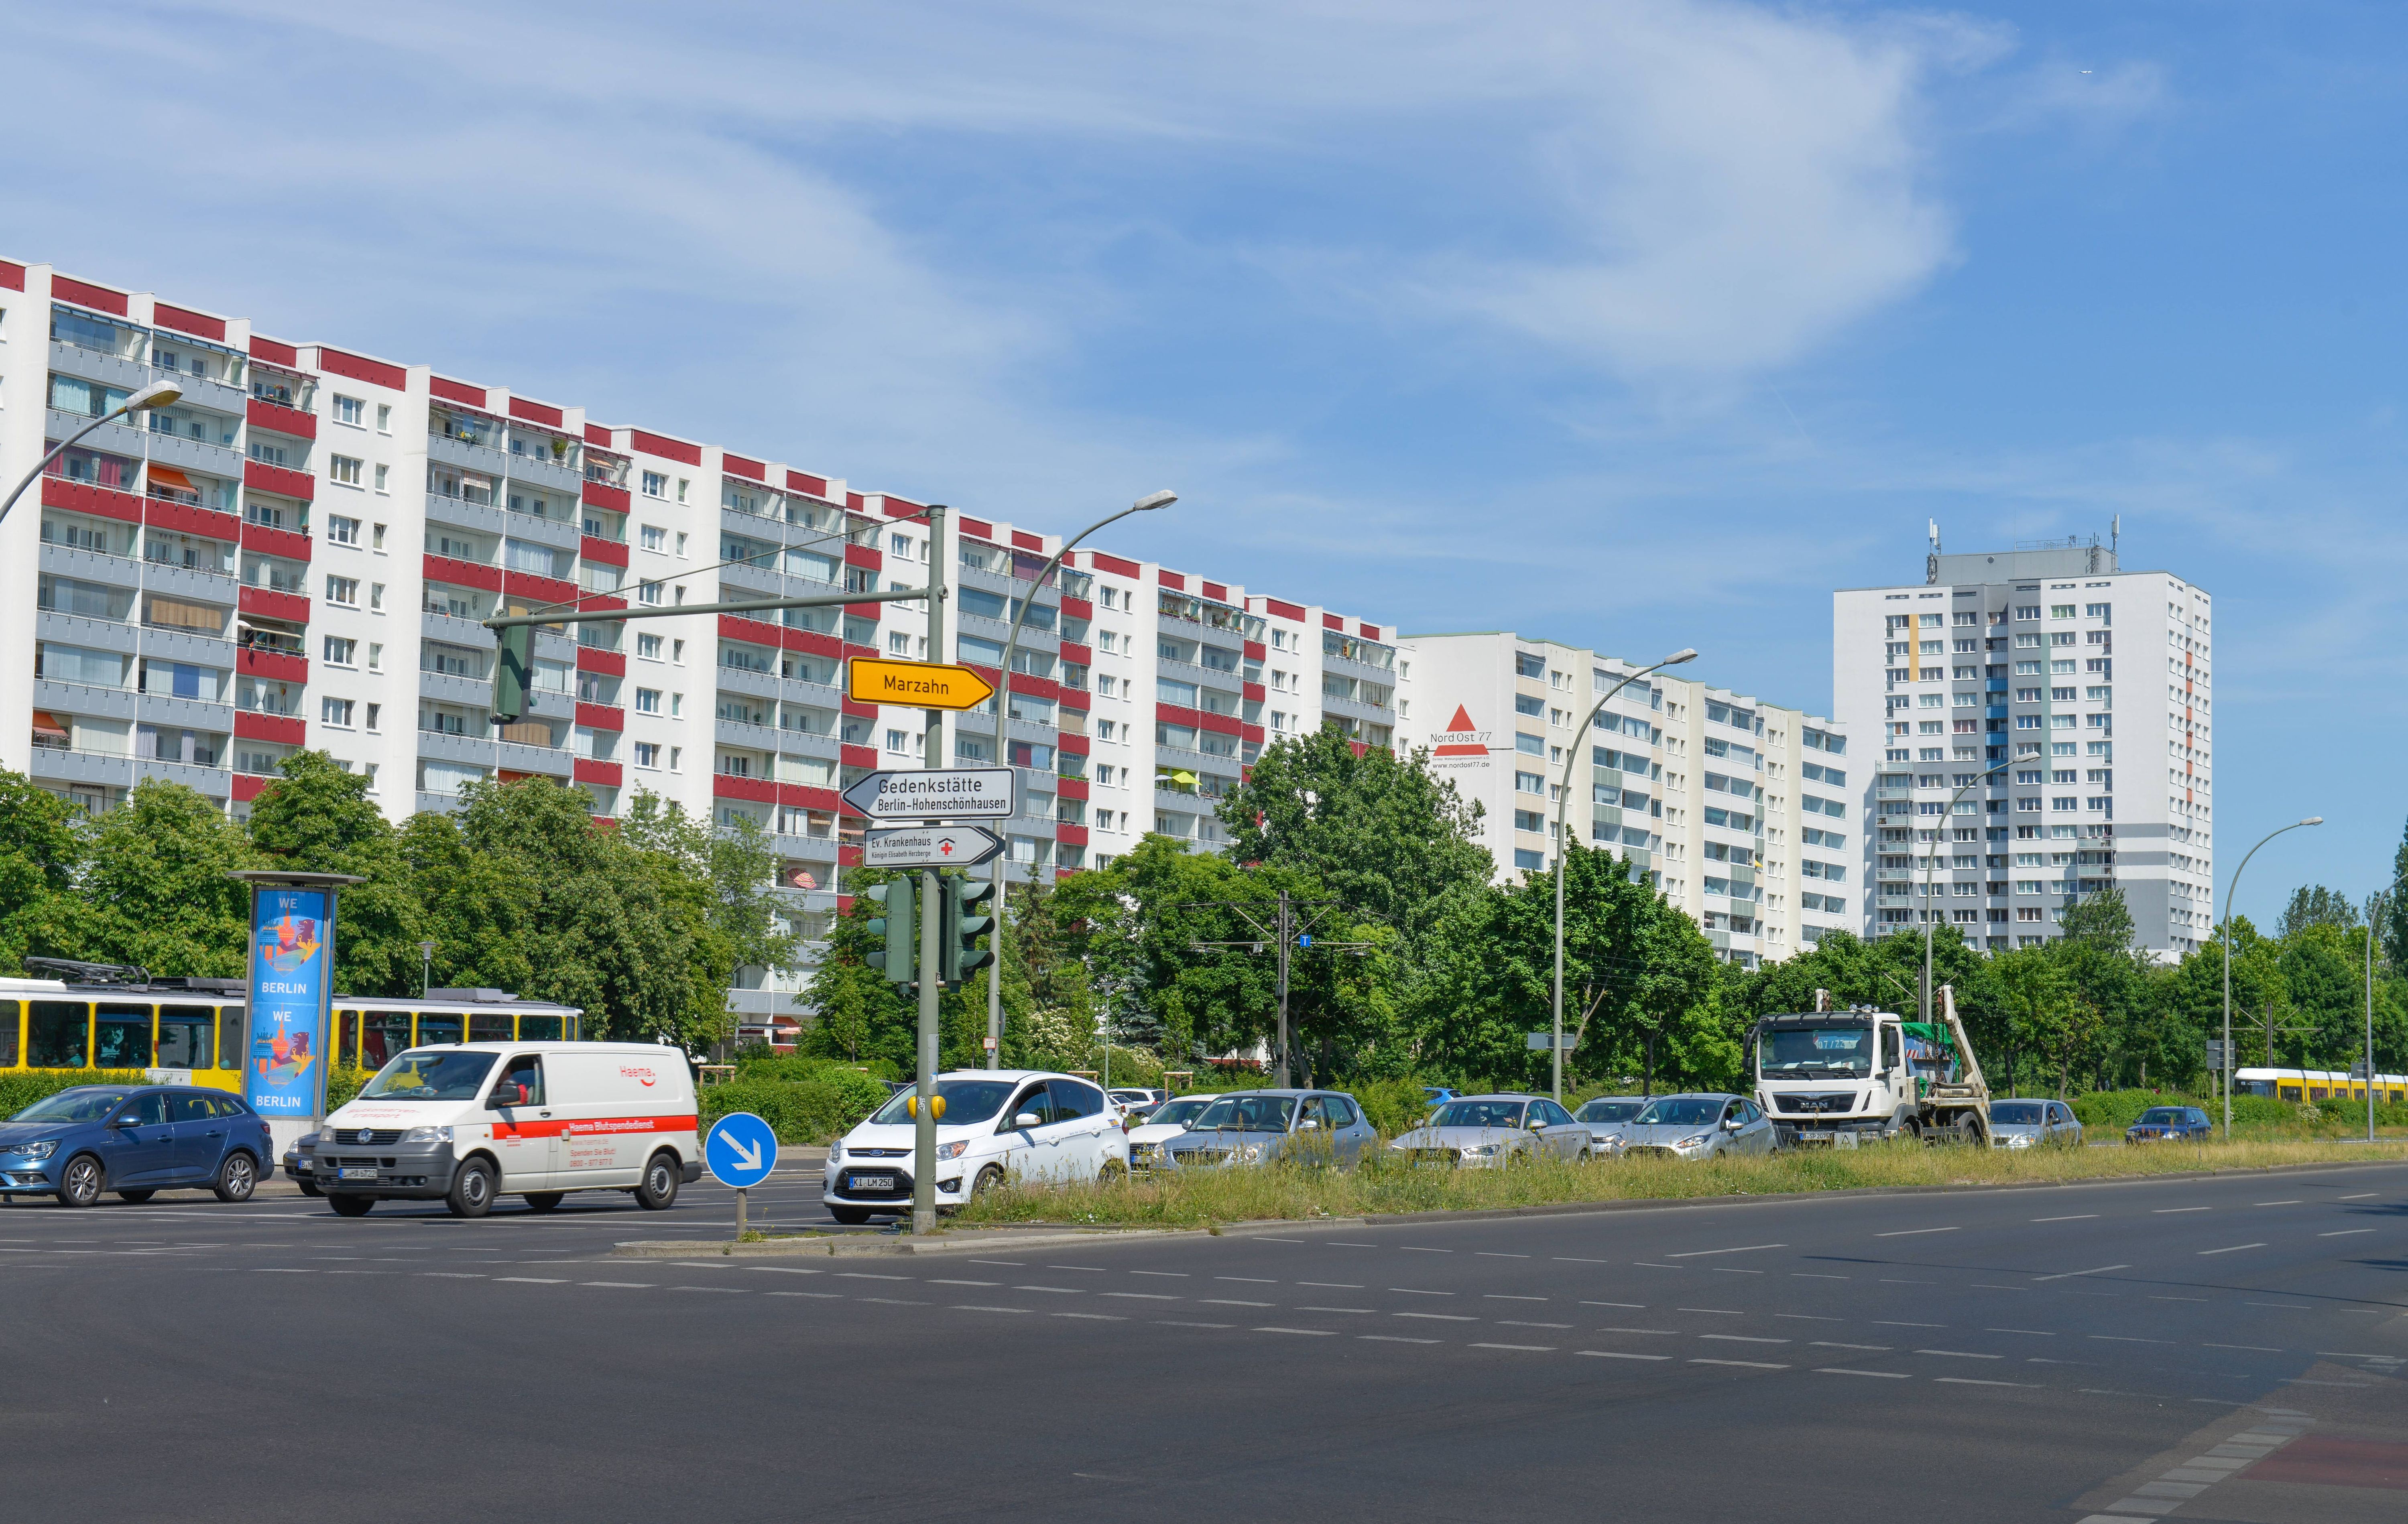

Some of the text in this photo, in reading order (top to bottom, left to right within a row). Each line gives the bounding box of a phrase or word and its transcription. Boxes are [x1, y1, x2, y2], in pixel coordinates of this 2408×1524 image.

[884, 675, 949, 695] Marzahn
[1431, 732, 1492, 742] Nord Ost 77
[879, 777, 982, 794] Gedenkstätte
[878, 797, 1006, 811] Berlin-Hohenschönhausen
[872, 836, 931, 848] Ev. Krankenhaus
[872, 851, 887, 860] Königin
[909, 850, 931, 858] Herzberge
[279, 898, 298, 909] WE
[262, 982, 307, 994] BERLIN
[273, 1011, 292, 1022] WE
[256, 1095, 301, 1107] BERLIN
[569, 1123, 594, 1132] Haema
[854, 1179, 892, 1187] KI LM 250
